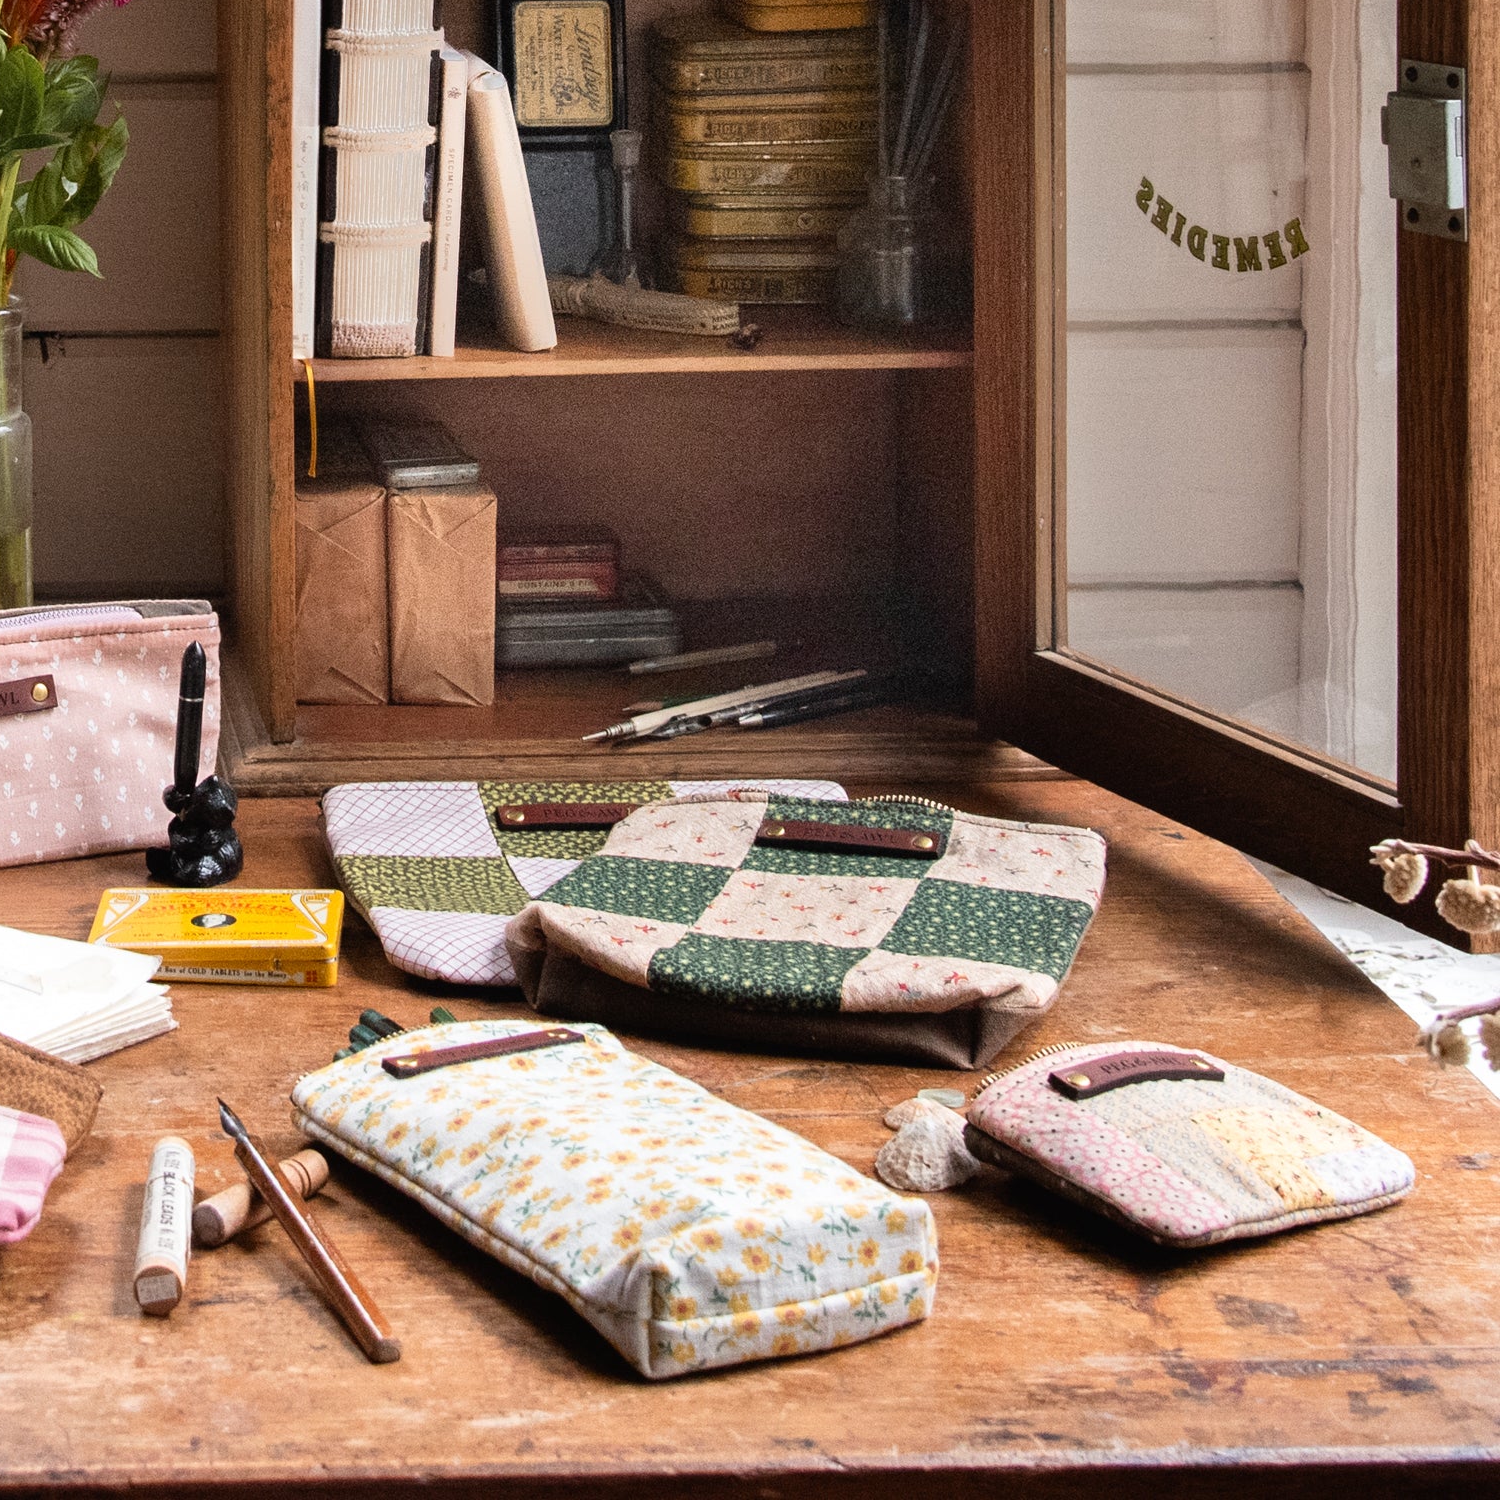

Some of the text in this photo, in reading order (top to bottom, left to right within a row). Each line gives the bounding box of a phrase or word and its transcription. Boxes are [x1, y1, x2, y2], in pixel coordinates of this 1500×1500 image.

[446, 148, 455, 194] SPECIMEN
[445, 198, 453, 227] CARDS
[188, 967, 207, 975] COLD
[210, 967, 241, 976] TABLETS
[160, 1200, 175, 1226] LEADS
